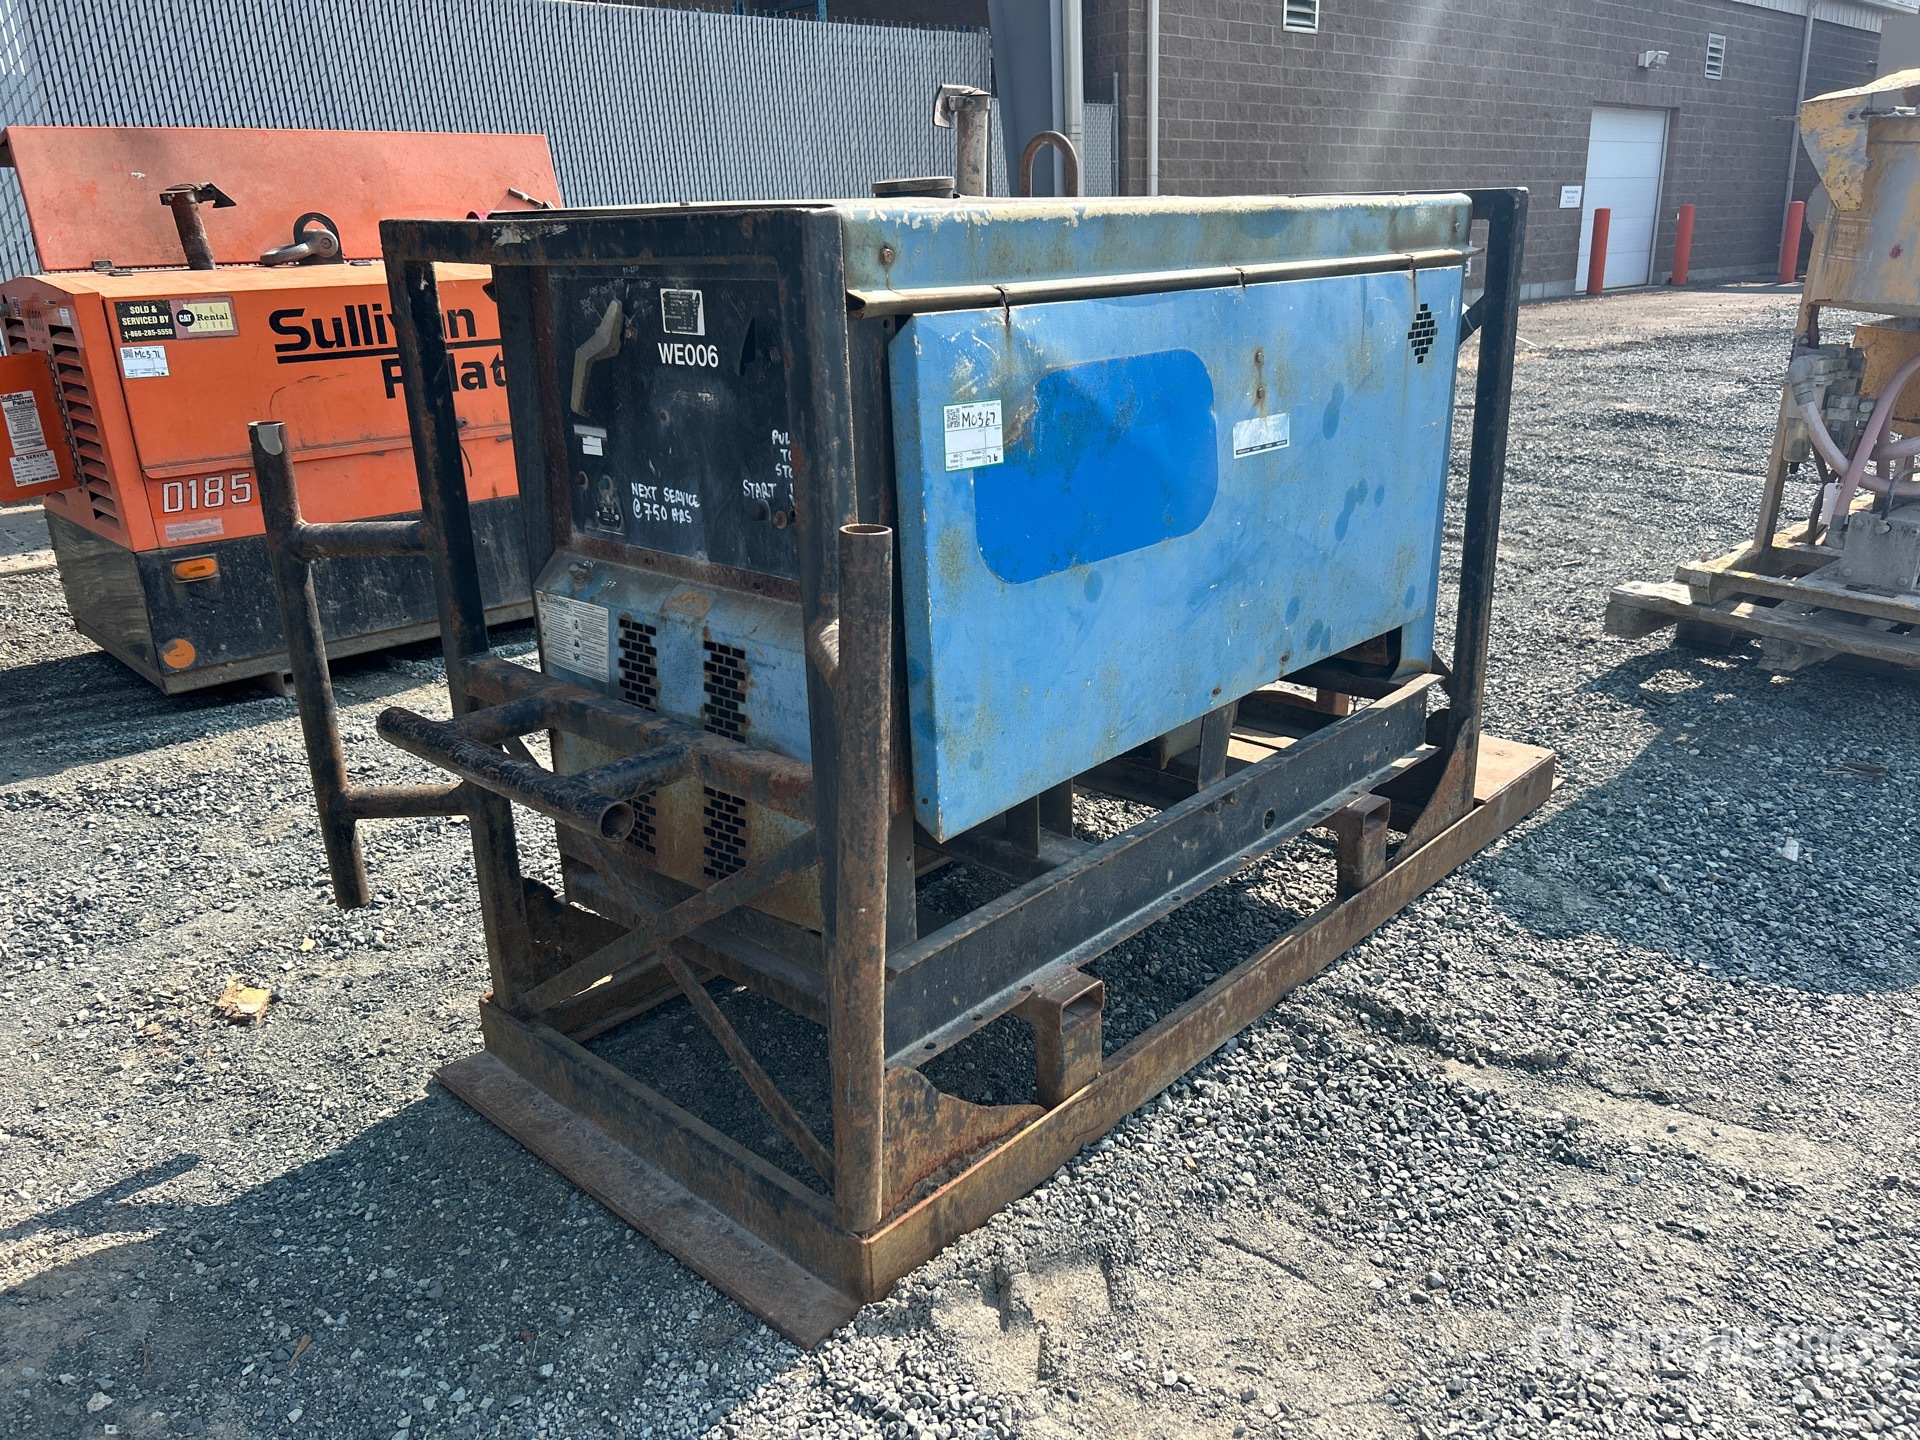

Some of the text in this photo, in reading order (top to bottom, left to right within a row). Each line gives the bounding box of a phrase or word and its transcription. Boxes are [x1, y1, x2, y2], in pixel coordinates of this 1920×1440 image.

[129, 305, 158, 315] SOLD &
[178, 312, 229, 323] CAT Rental
[121, 314, 169, 326] SERVICED BY
[268, 303, 477, 353] Sullin
[657, 342, 719, 368] WE006
[381, 352, 507, 399] Plat
[771, 429, 791, 445] PUL
[775, 462, 793, 478] STO
[631, 482, 701, 509] NEXT SERVICE
[742, 479, 778, 499] START
[671, 507, 693, 524] HRS
[583, 560, 596, 568] ON
[601, 580, 617, 589] OFF
